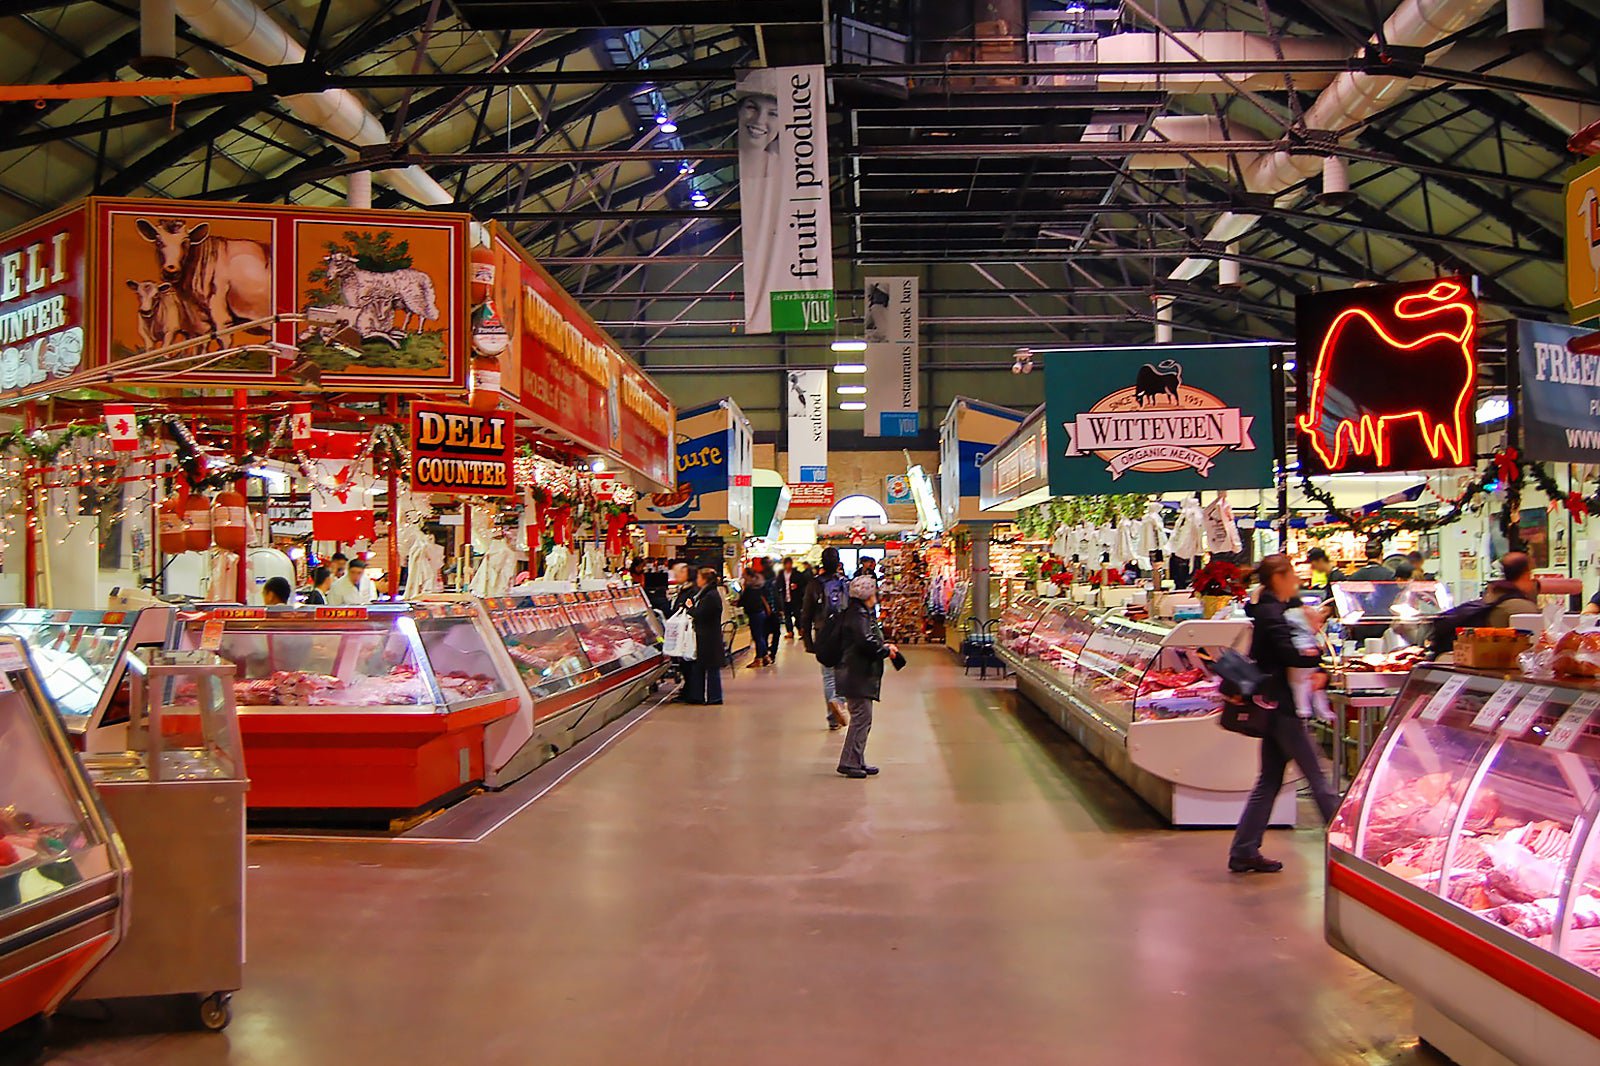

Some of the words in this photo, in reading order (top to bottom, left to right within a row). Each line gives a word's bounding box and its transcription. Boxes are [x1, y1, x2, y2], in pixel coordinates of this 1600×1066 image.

[785, 73, 823, 190] produce
[789, 209, 818, 280] fruit
[900, 280, 912, 304] bars
[801, 300, 830, 331] you
[900, 308, 912, 339] snack
[901, 346, 912, 408] restaurants
[810, 394, 822, 442] seafood
[1108, 396, 1132, 411] SINCE
[1184, 394, 1204, 407] 1951
[418, 411, 505, 450] DELI
[1087, 412, 1225, 445] WITTEVEEN
[417, 457, 508, 487] COUNTER
[1120, 447, 1168, 466] ORGANIC
[1169, 449, 1205, 466] MEATS
